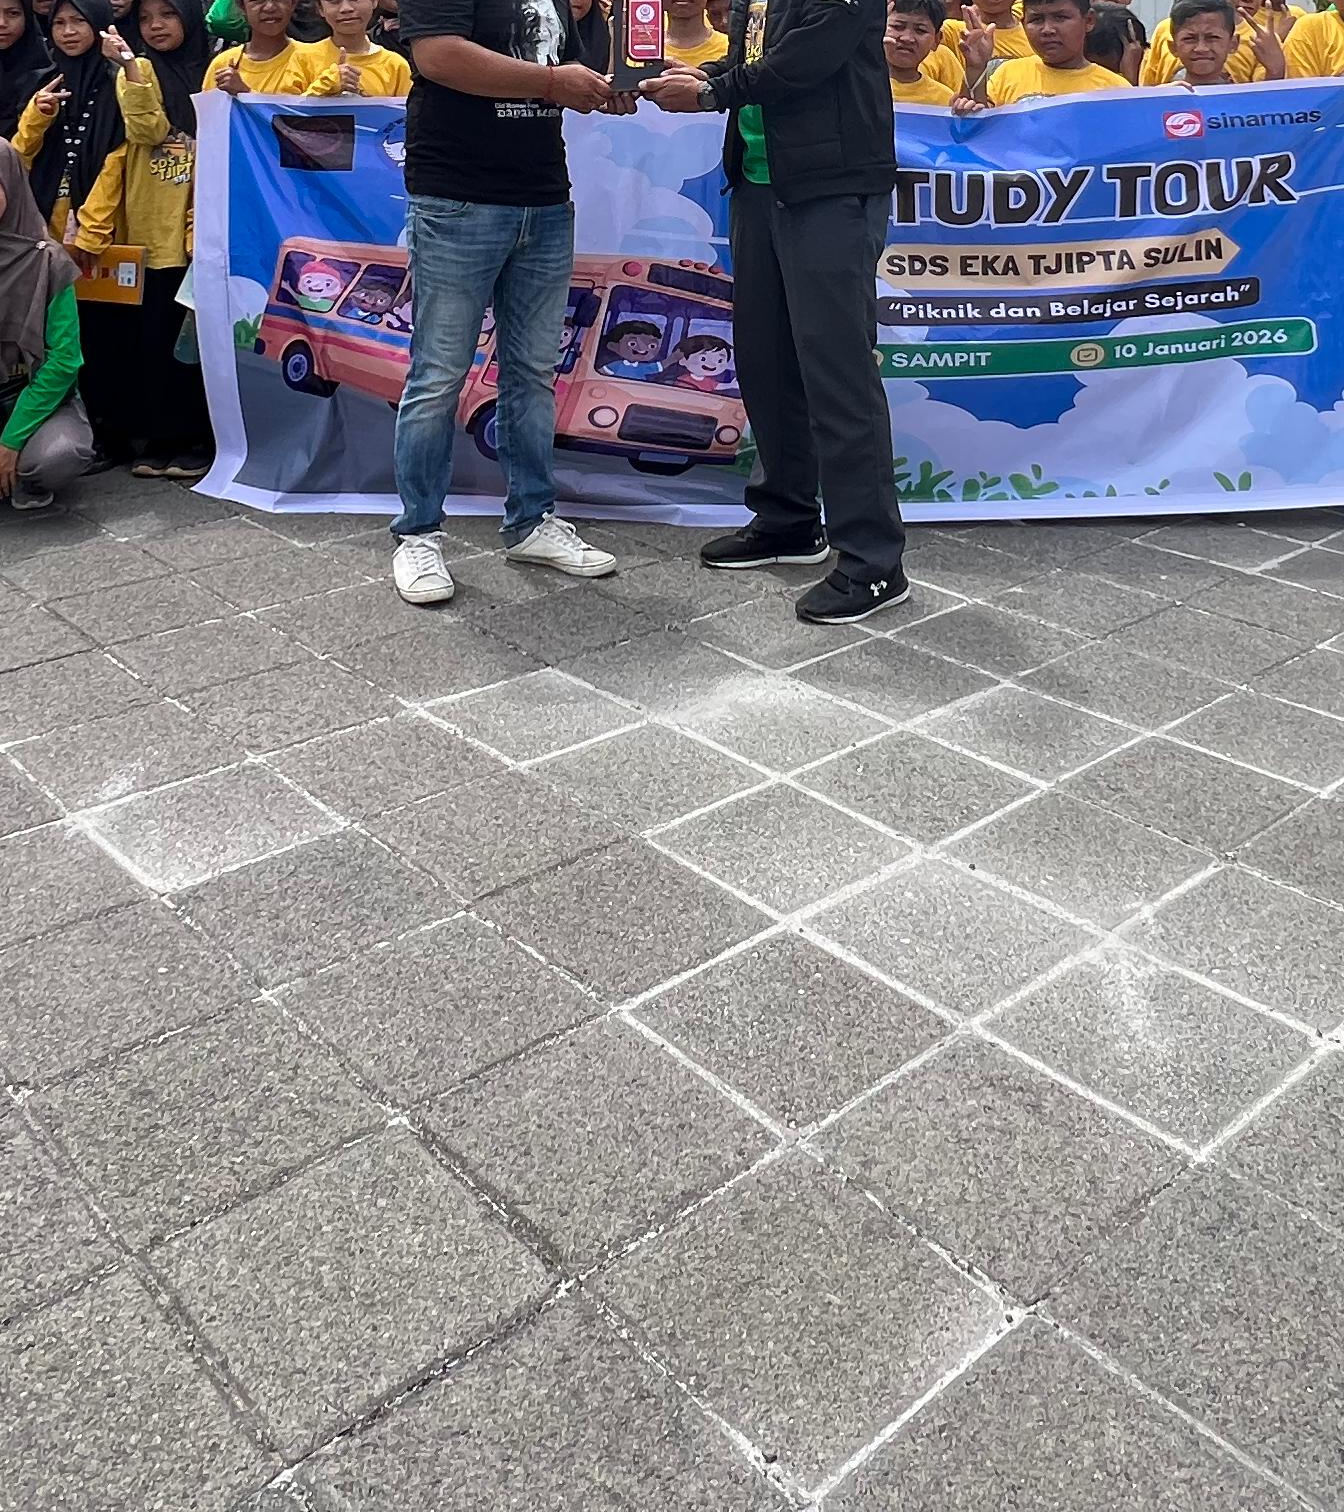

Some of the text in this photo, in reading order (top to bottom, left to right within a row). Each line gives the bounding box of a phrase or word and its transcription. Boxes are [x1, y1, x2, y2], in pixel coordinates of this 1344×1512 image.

[1206, 109, 1322, 130] sinarmas
[158, 162, 192, 180] TJIPT
[892, 151, 1299, 228] TUDY TOUR
[886, 237, 1224, 276] SDS EKA TJIPTA SULIN
[888, 302, 981, 319] “Piknik
[989, 302, 1041, 318] dan
[1049, 297, 1138, 317] Belajar
[1113, 328, 1288, 359] 10 Januari 2026
[891, 352, 992, 368] SAMPIT
